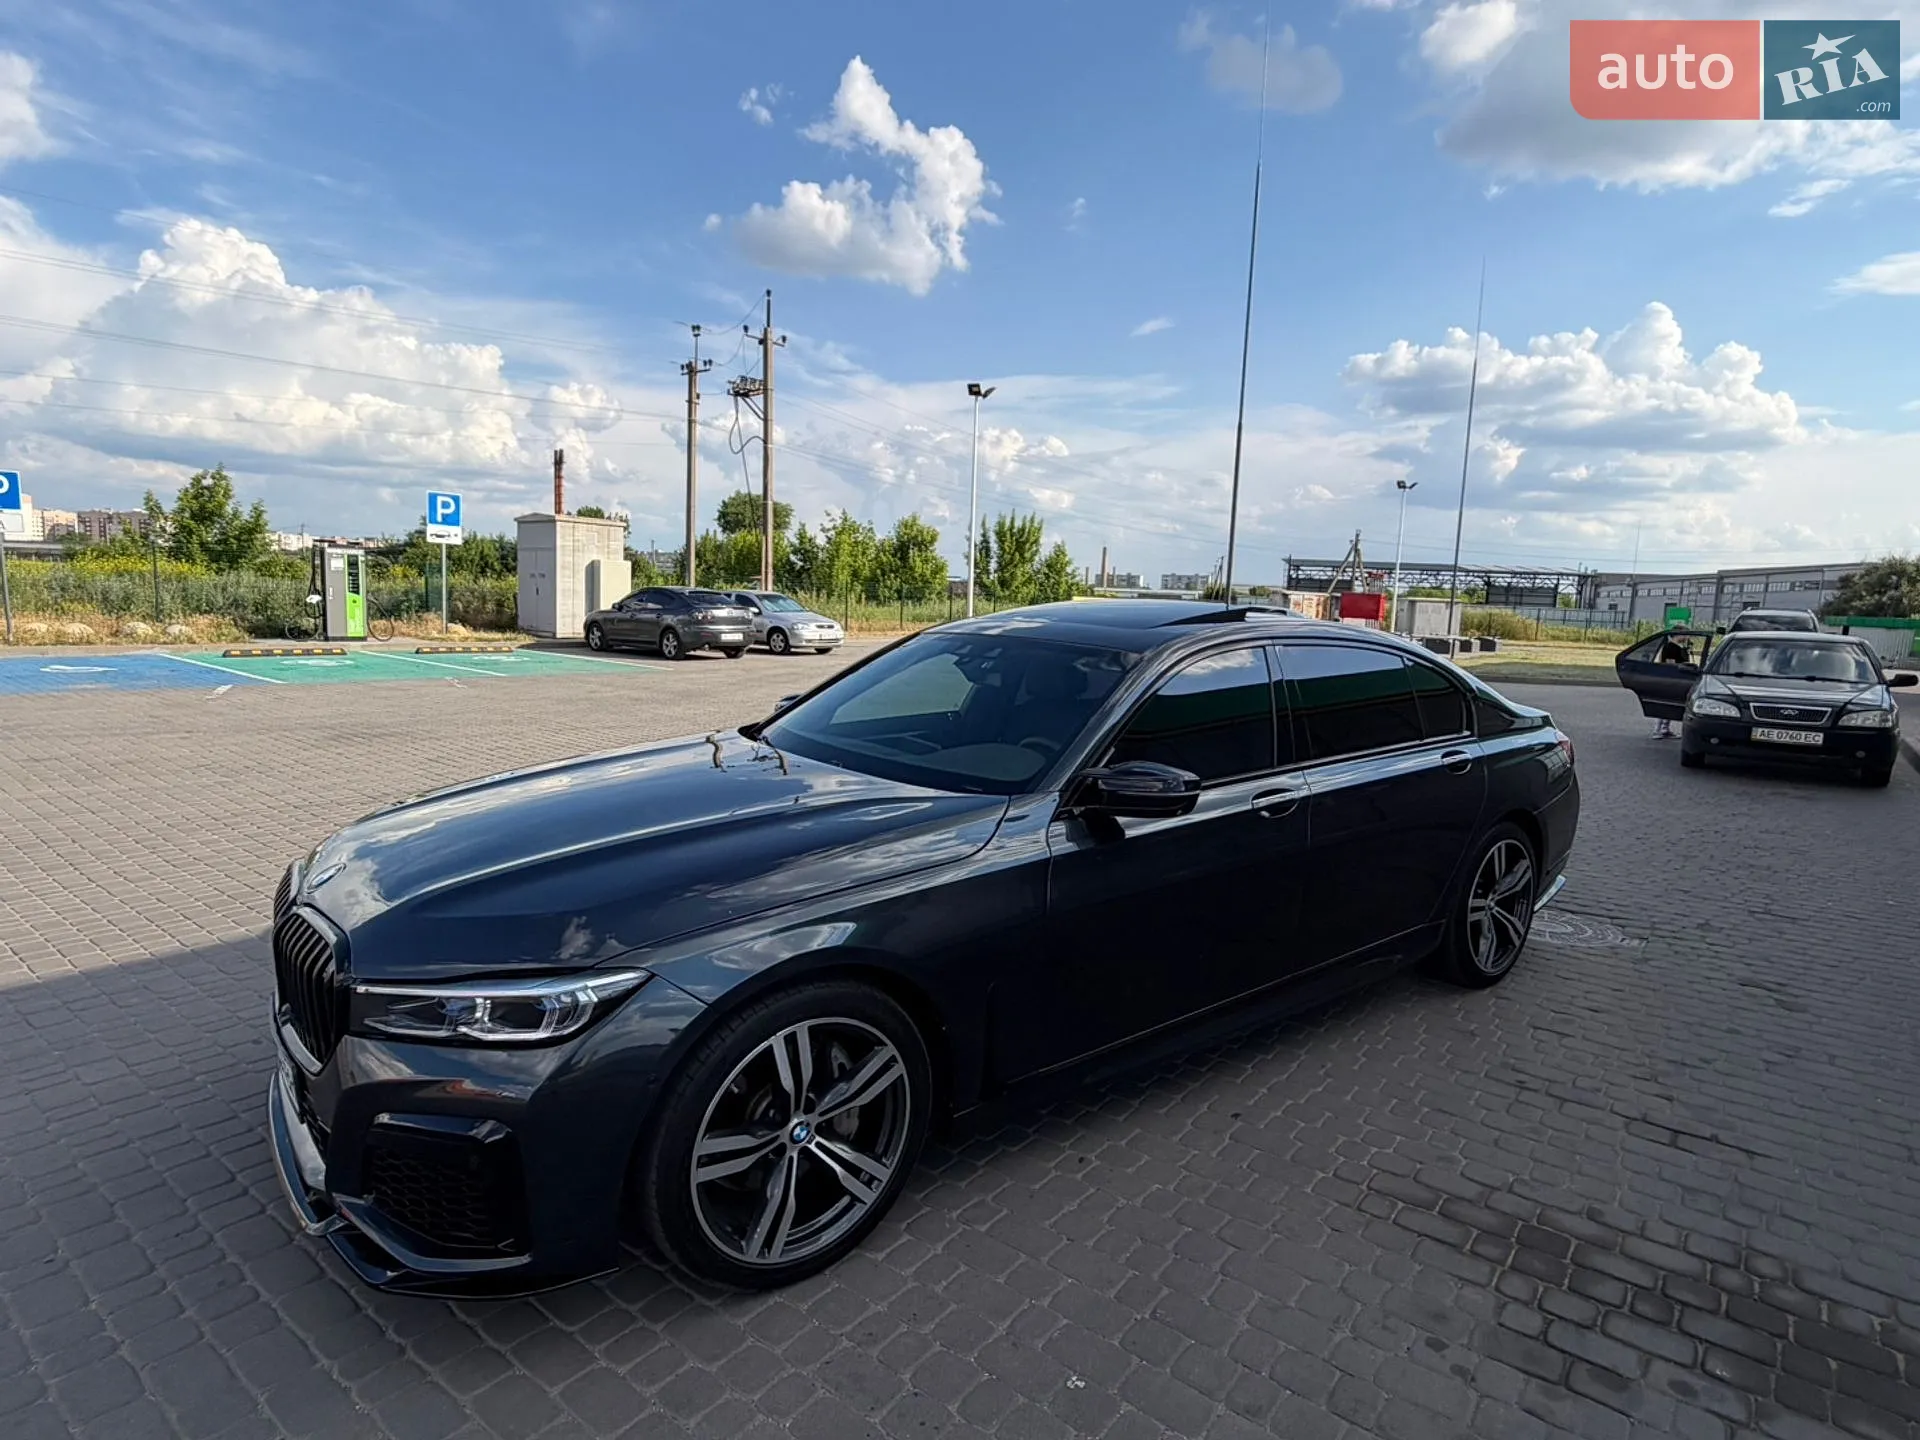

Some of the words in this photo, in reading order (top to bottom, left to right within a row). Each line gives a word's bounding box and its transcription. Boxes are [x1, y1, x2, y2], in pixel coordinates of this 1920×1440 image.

[436, 495, 456, 523] P
[1759, 729, 1775, 739] AE
[1776, 731, 1802, 741] 0760
[1804, 733, 1821, 743] EC
